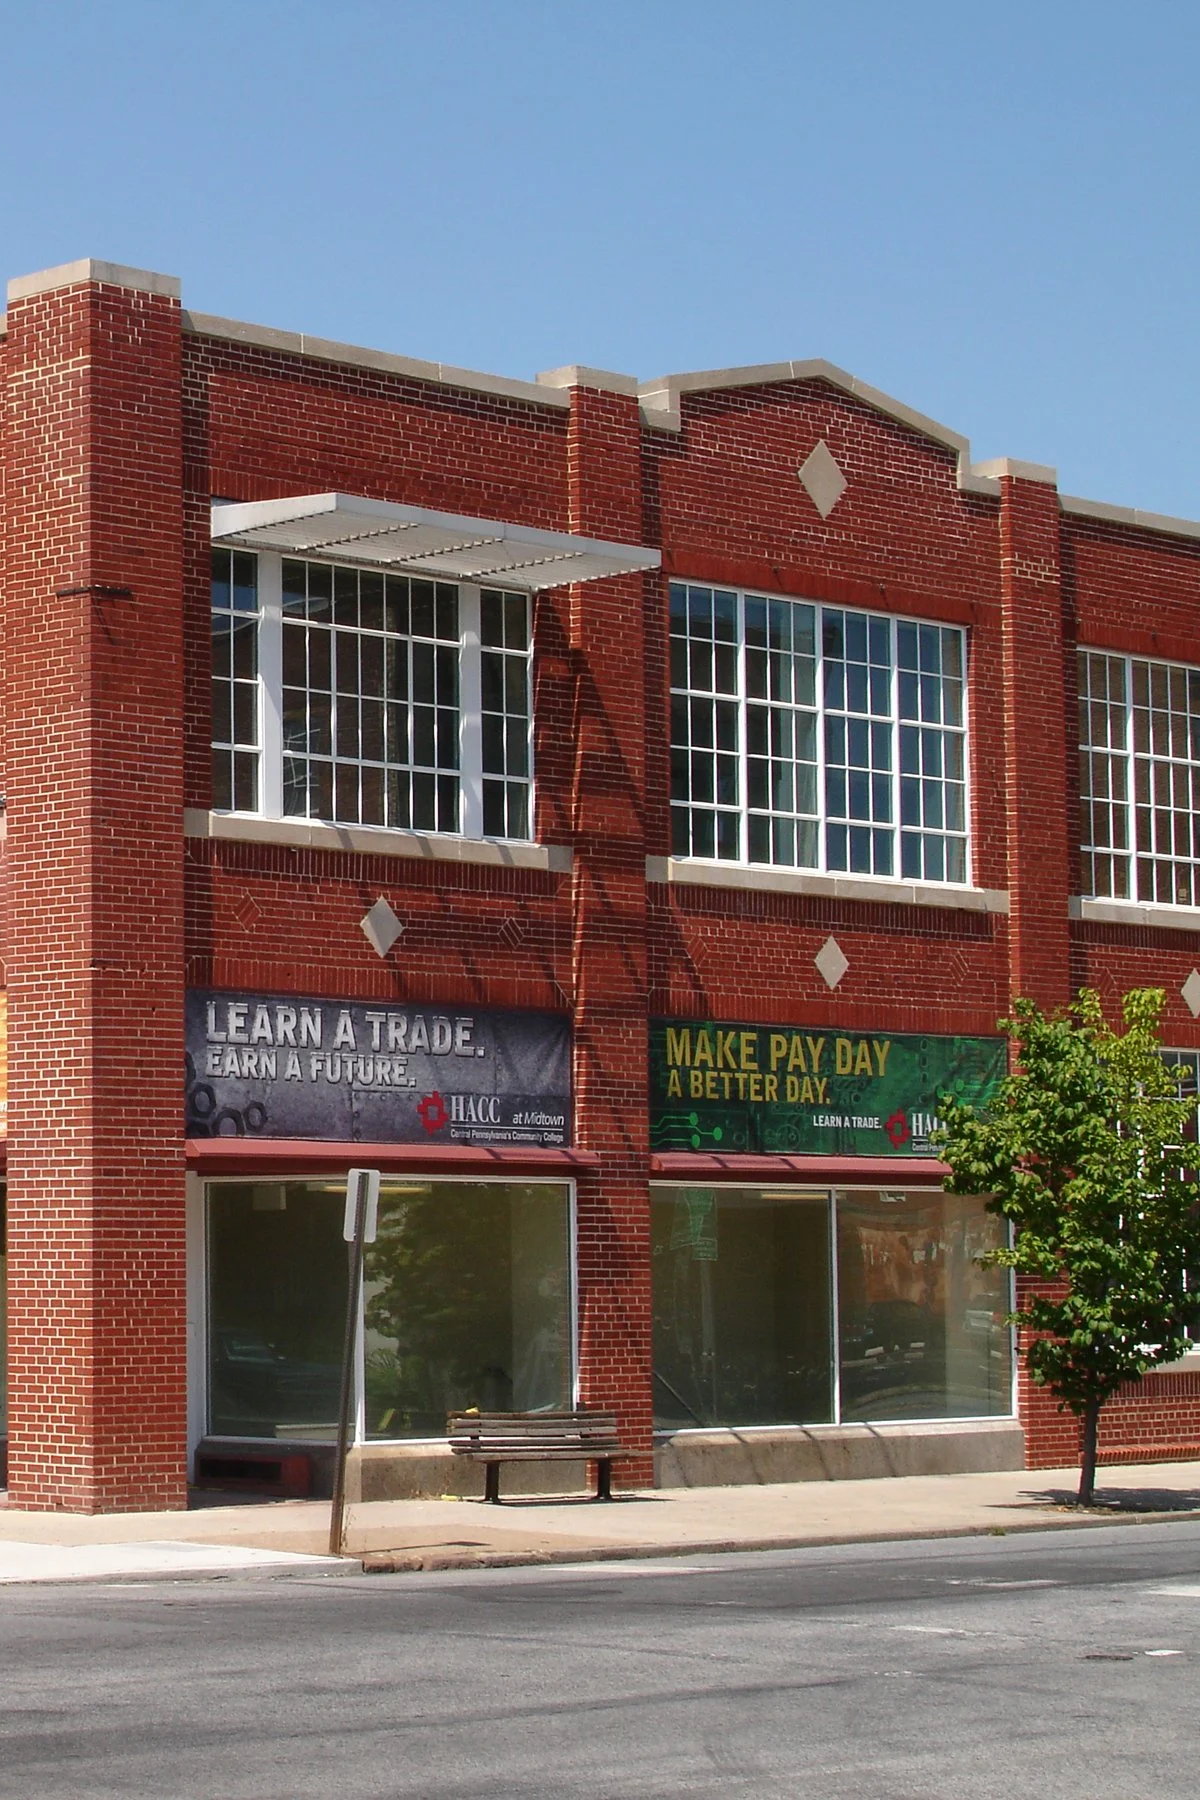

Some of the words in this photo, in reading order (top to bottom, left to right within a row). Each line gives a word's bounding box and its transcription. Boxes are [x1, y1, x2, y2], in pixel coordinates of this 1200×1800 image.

[206, 1001, 322, 1049] LEARN
[333, 1010, 356, 1050] A
[365, 1012, 486, 1057] TRADE.
[206, 1046, 277, 1080] EARN
[284, 1050, 301, 1082] A
[310, 1051, 416, 1087] FUTURE.
[666, 1027, 758, 1070] MAKE
[770, 1034, 826, 1074] PAY
[835, 1037, 891, 1077] DAY
[667, 1069, 682, 1098] A
[690, 1070, 778, 1103] BETTER
[786, 1075, 831, 1105] DAY.
[450, 1095, 500, 1123] HACC
[512, 1112, 523, 1125] at
[524, 1111, 565, 1126] Midtown
[813, 1115, 842, 1128] LEARN
[843, 1116, 852, 1128] A
[852, 1116, 882, 1129] TRADE.
[450, 1128, 471, 1139] Central
[471, 1129, 512, 1141] Pennsylvania's
[512, 1131, 543, 1142] Community
[543, 1132, 564, 1143] College
